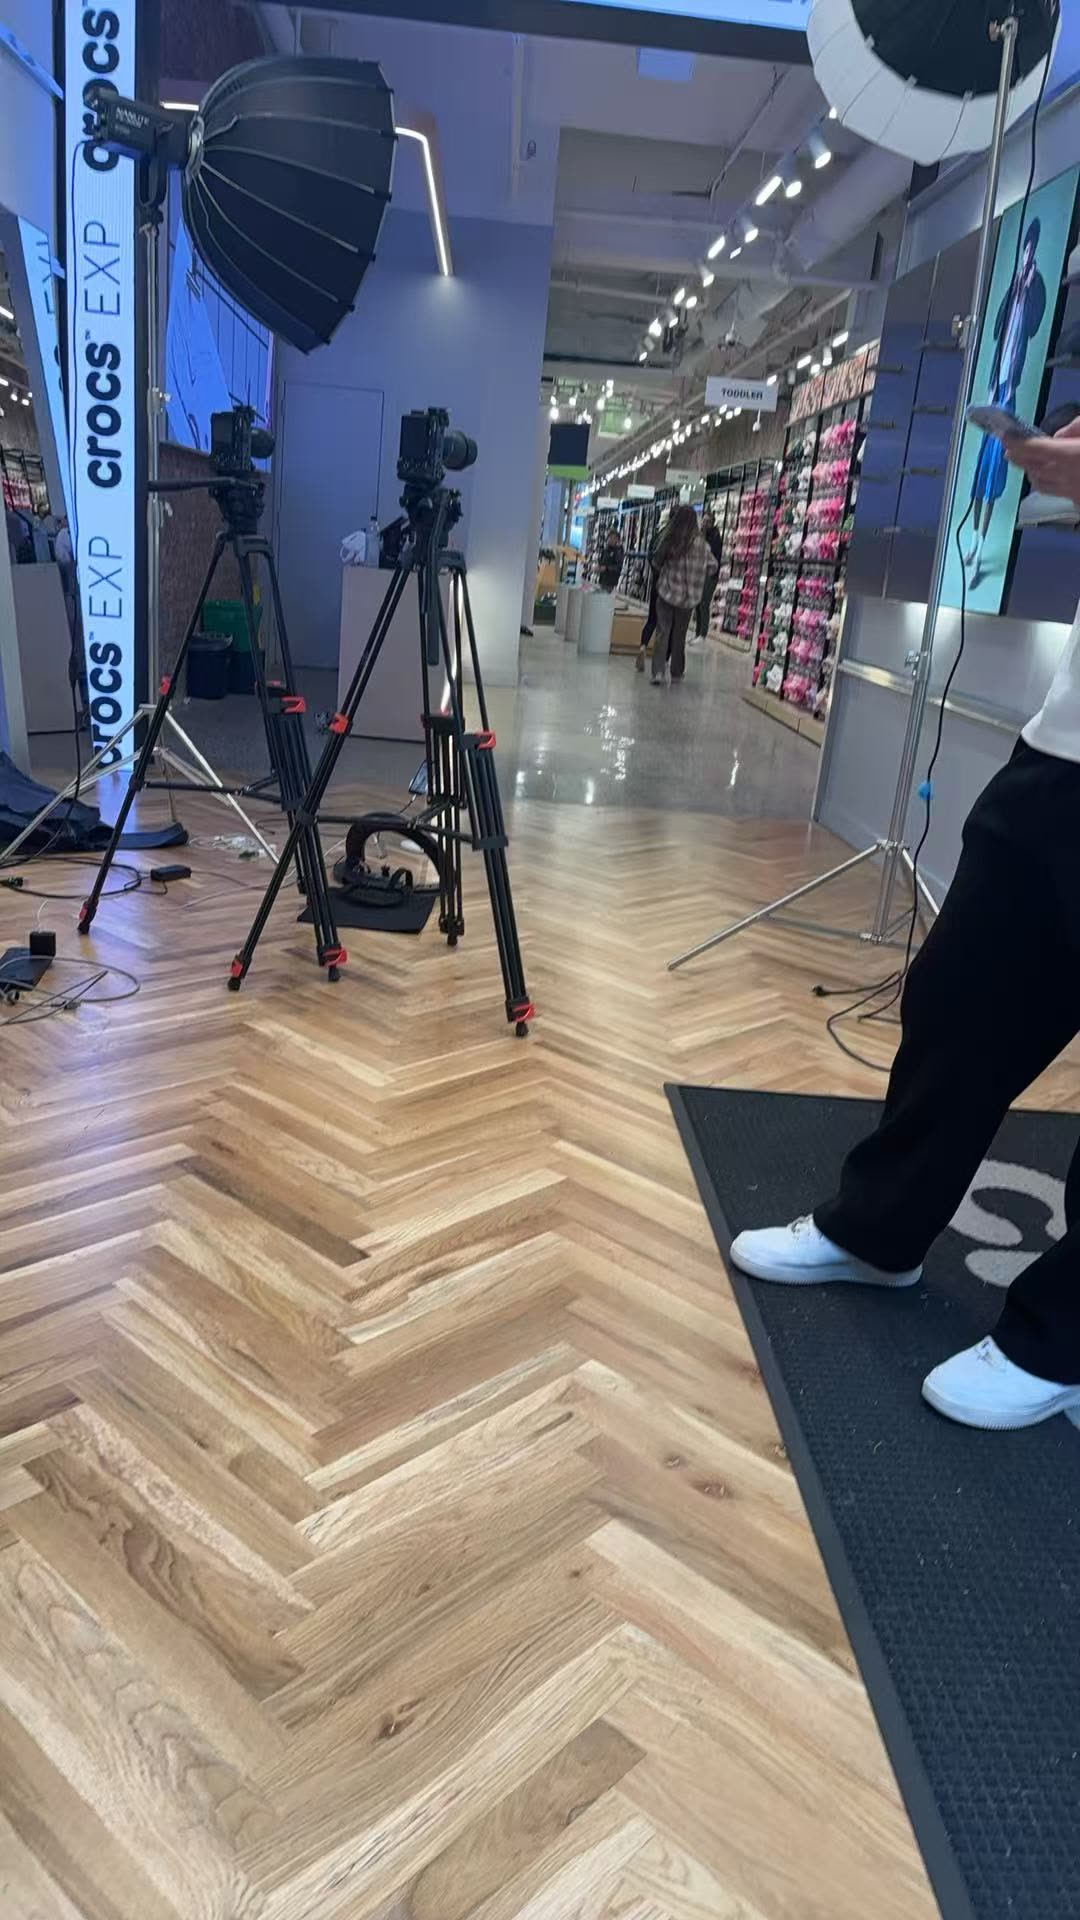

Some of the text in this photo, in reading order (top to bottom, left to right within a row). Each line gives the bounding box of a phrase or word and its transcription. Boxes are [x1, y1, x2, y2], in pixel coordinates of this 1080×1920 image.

[84, 221, 120, 316] EXP
[721, 387, 763, 400] TODDLER
[88, 536, 122, 619] EXP
